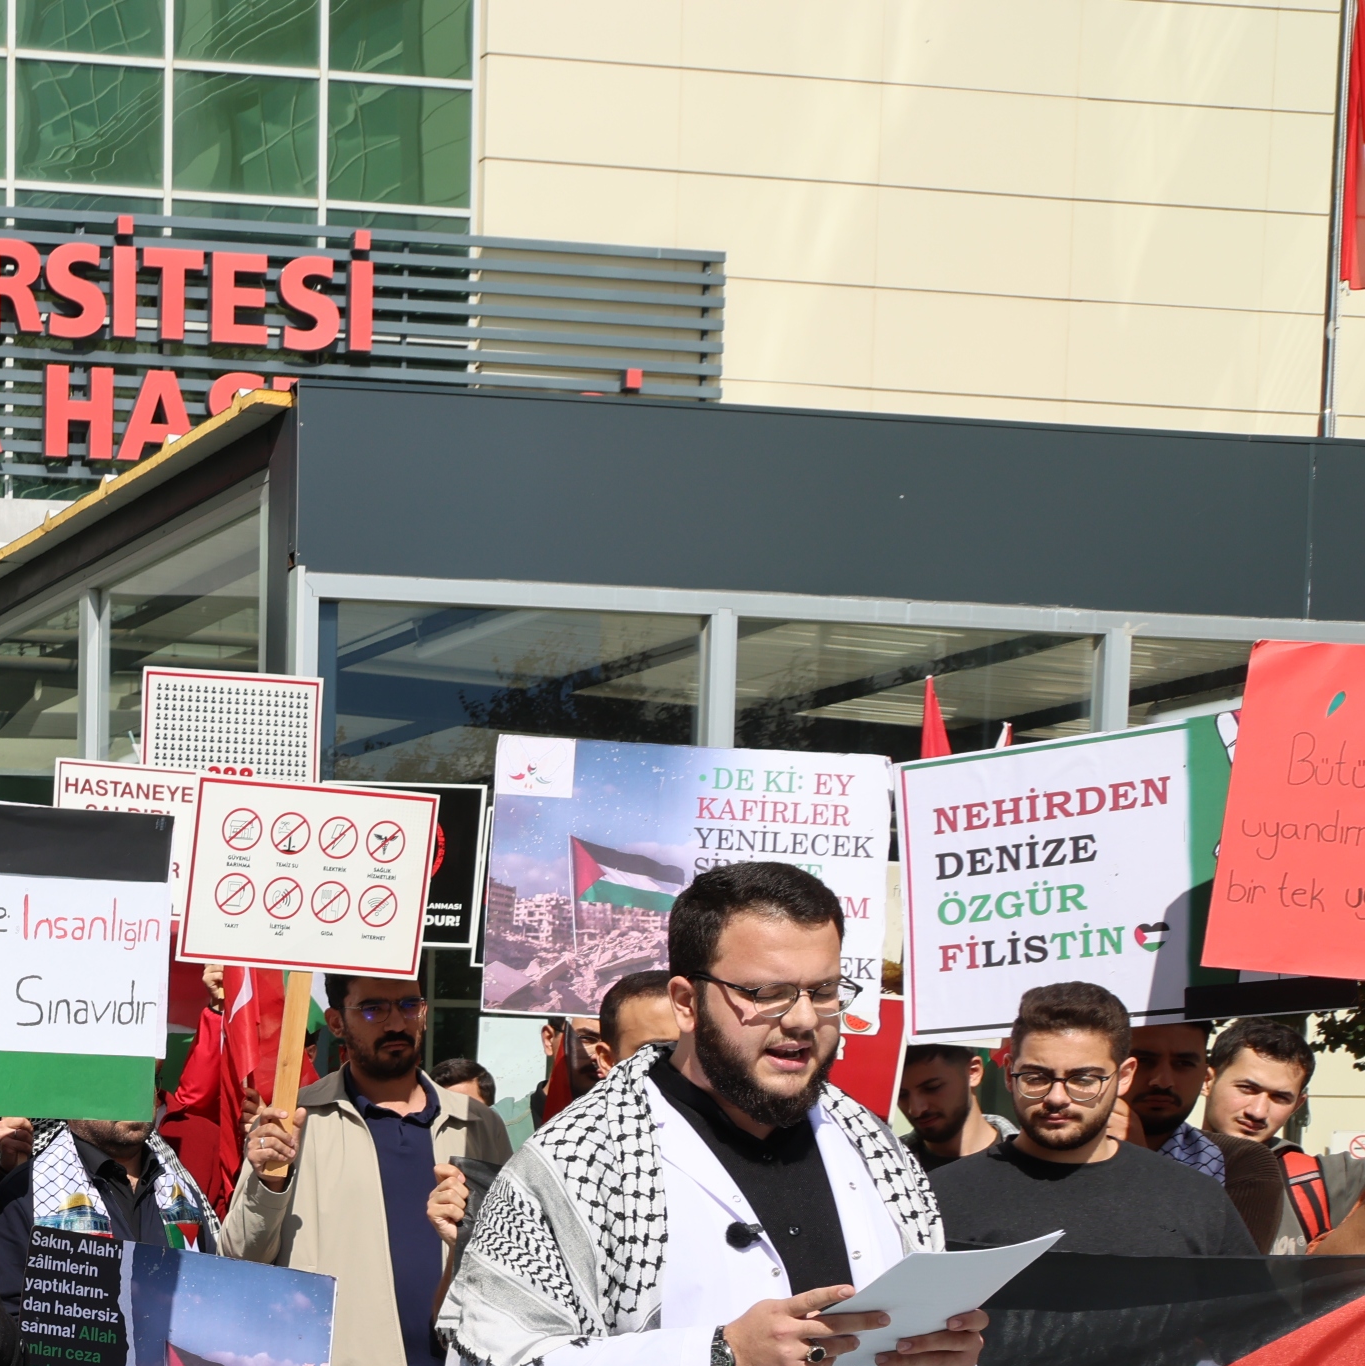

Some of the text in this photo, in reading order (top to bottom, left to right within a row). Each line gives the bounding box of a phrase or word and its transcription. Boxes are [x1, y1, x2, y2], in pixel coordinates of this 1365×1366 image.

[64, 777, 194, 803] HASTANEYE
[712, 767, 754, 791] DE
[813, 773, 855, 796] EY
[696, 795, 851, 827] KAFİRLER
[933, 776, 1170, 835] NEHİRDEN
[694, 825, 874, 858] YENİLECEK
[936, 834, 1098, 880] DENİZE
[938, 880, 1087, 925] ÖZGÜR
[1227, 870, 1266, 904] bir
[1278, 872, 1325, 912] tek
[939, 923, 1125, 973] FİLİSTİN
[16, 975, 157, 1027] Sınavıdır
[31, 1231, 74, 1254] Sakın,
[27, 1254, 98, 1277] zâlimlerin
[24, 1277, 109, 1299] yaptıkların-
[22, 1297, 119, 1323] dan habersiz
[21, 1321, 117, 1344] sanma! Allah
[27, 1341, 101, 1364] nları ceza
